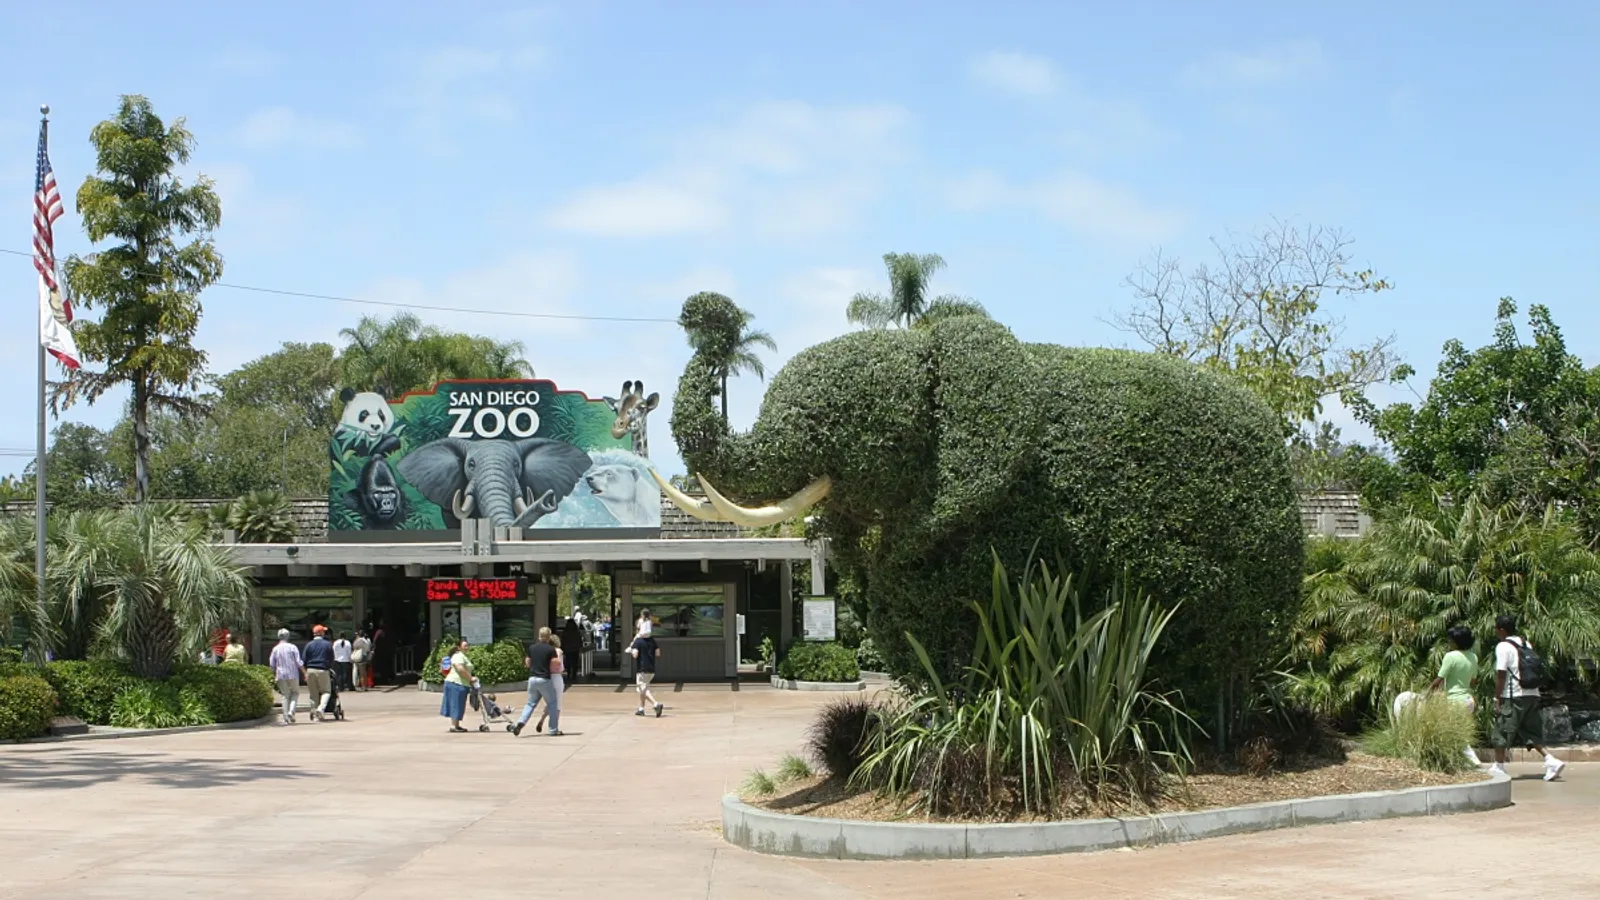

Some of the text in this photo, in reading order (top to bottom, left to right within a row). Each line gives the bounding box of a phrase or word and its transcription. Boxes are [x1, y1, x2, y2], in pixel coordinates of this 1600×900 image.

[450, 390, 540, 406] SAN DIEGO
[448, 407, 540, 438] ZOO
[427, 579, 516, 590] Panda Viewing
[427, 590, 450, 600] 9am
[469, 590, 516, 599] 5:30pm
